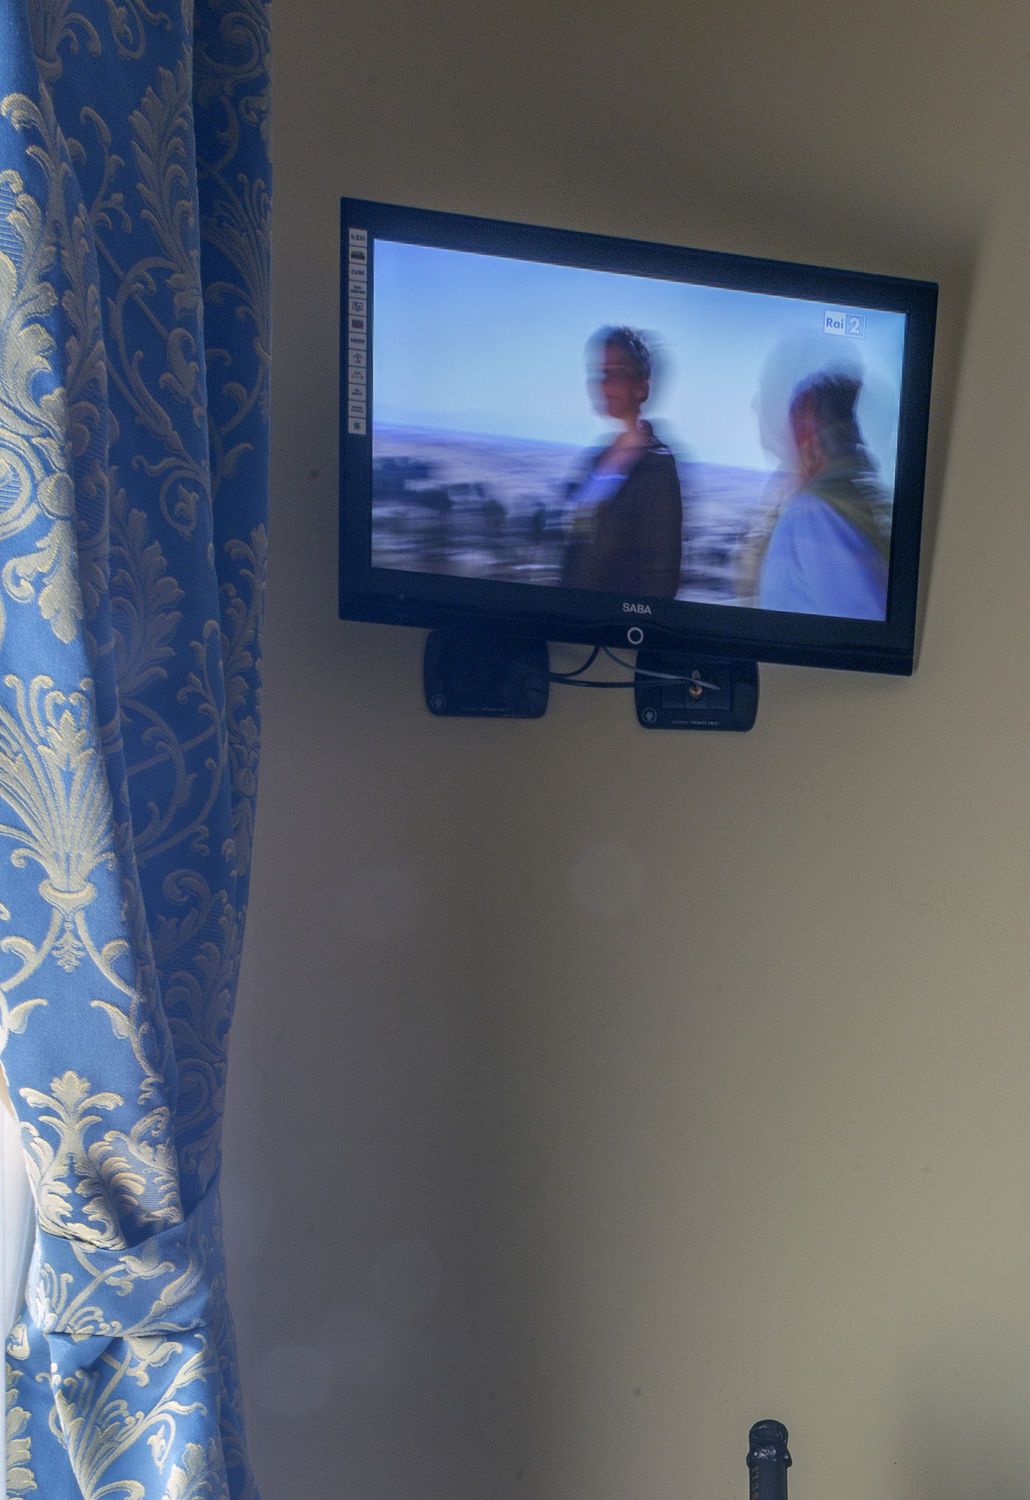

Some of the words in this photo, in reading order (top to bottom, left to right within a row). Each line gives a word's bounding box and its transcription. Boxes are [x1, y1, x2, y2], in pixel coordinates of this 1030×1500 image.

[826, 317, 844, 329] Rai
[849, 317, 860, 334] 2
[622, 602, 652, 615] SABA
